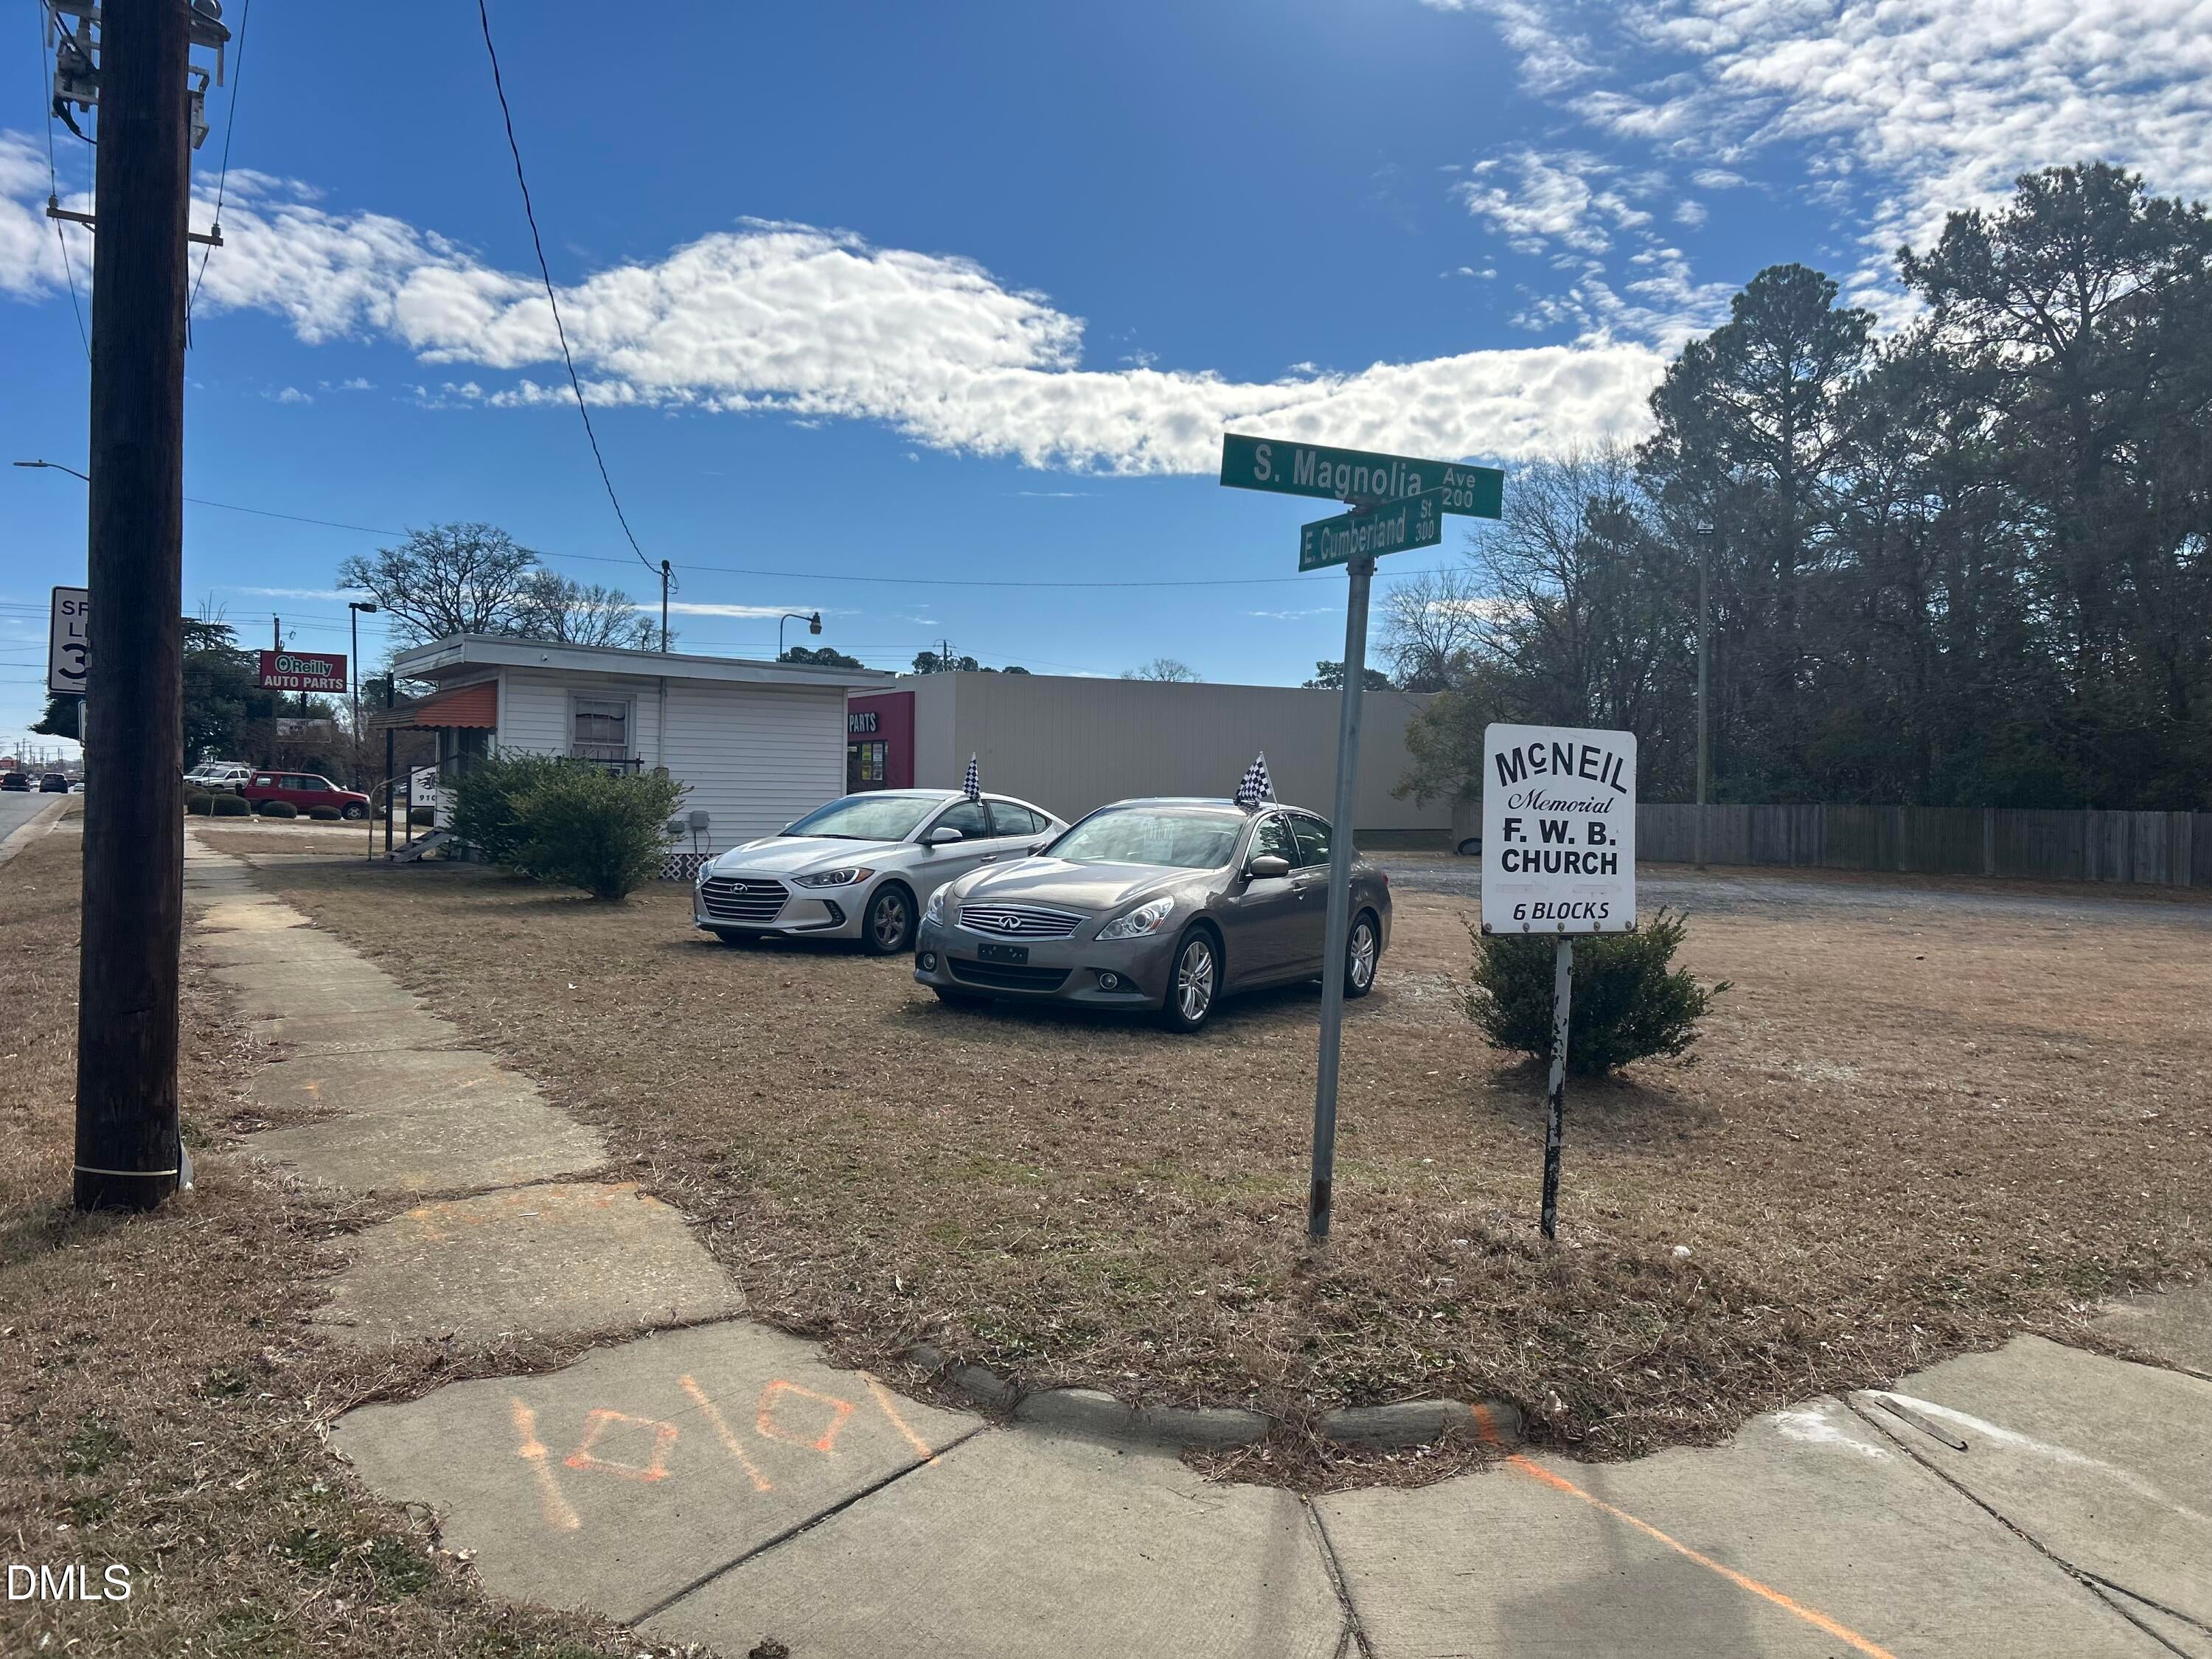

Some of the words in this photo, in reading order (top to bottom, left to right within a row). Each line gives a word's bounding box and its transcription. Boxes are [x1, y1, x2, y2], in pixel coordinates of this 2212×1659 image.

[1253, 443, 1281, 483] S.
[1293, 448, 1422, 500] Magnolia
[1442, 467, 1475, 488] Ave
[1420, 498, 1433, 518] St
[1441, 487, 1474, 509] 200
[1304, 531, 1316, 564] E.
[1320, 507, 1406, 557] Cumberland
[1415, 521, 1435, 543] 300
[275, 655, 333, 677] O'Reilly
[264, 675, 299, 687] AUTO
[303, 677, 344, 689] PARTS
[849, 712, 876, 732] PARTS
[1508, 788, 1614, 813] Memorial
[1503, 817, 1527, 842] F.
[1539, 819, 1575, 845] W.
[1587, 821, 1616, 846] B.
[1501, 849, 1618, 875] CHURCH
[1513, 903, 1526, 920] 6
[1531, 902, 1609, 919] BLOCKS
